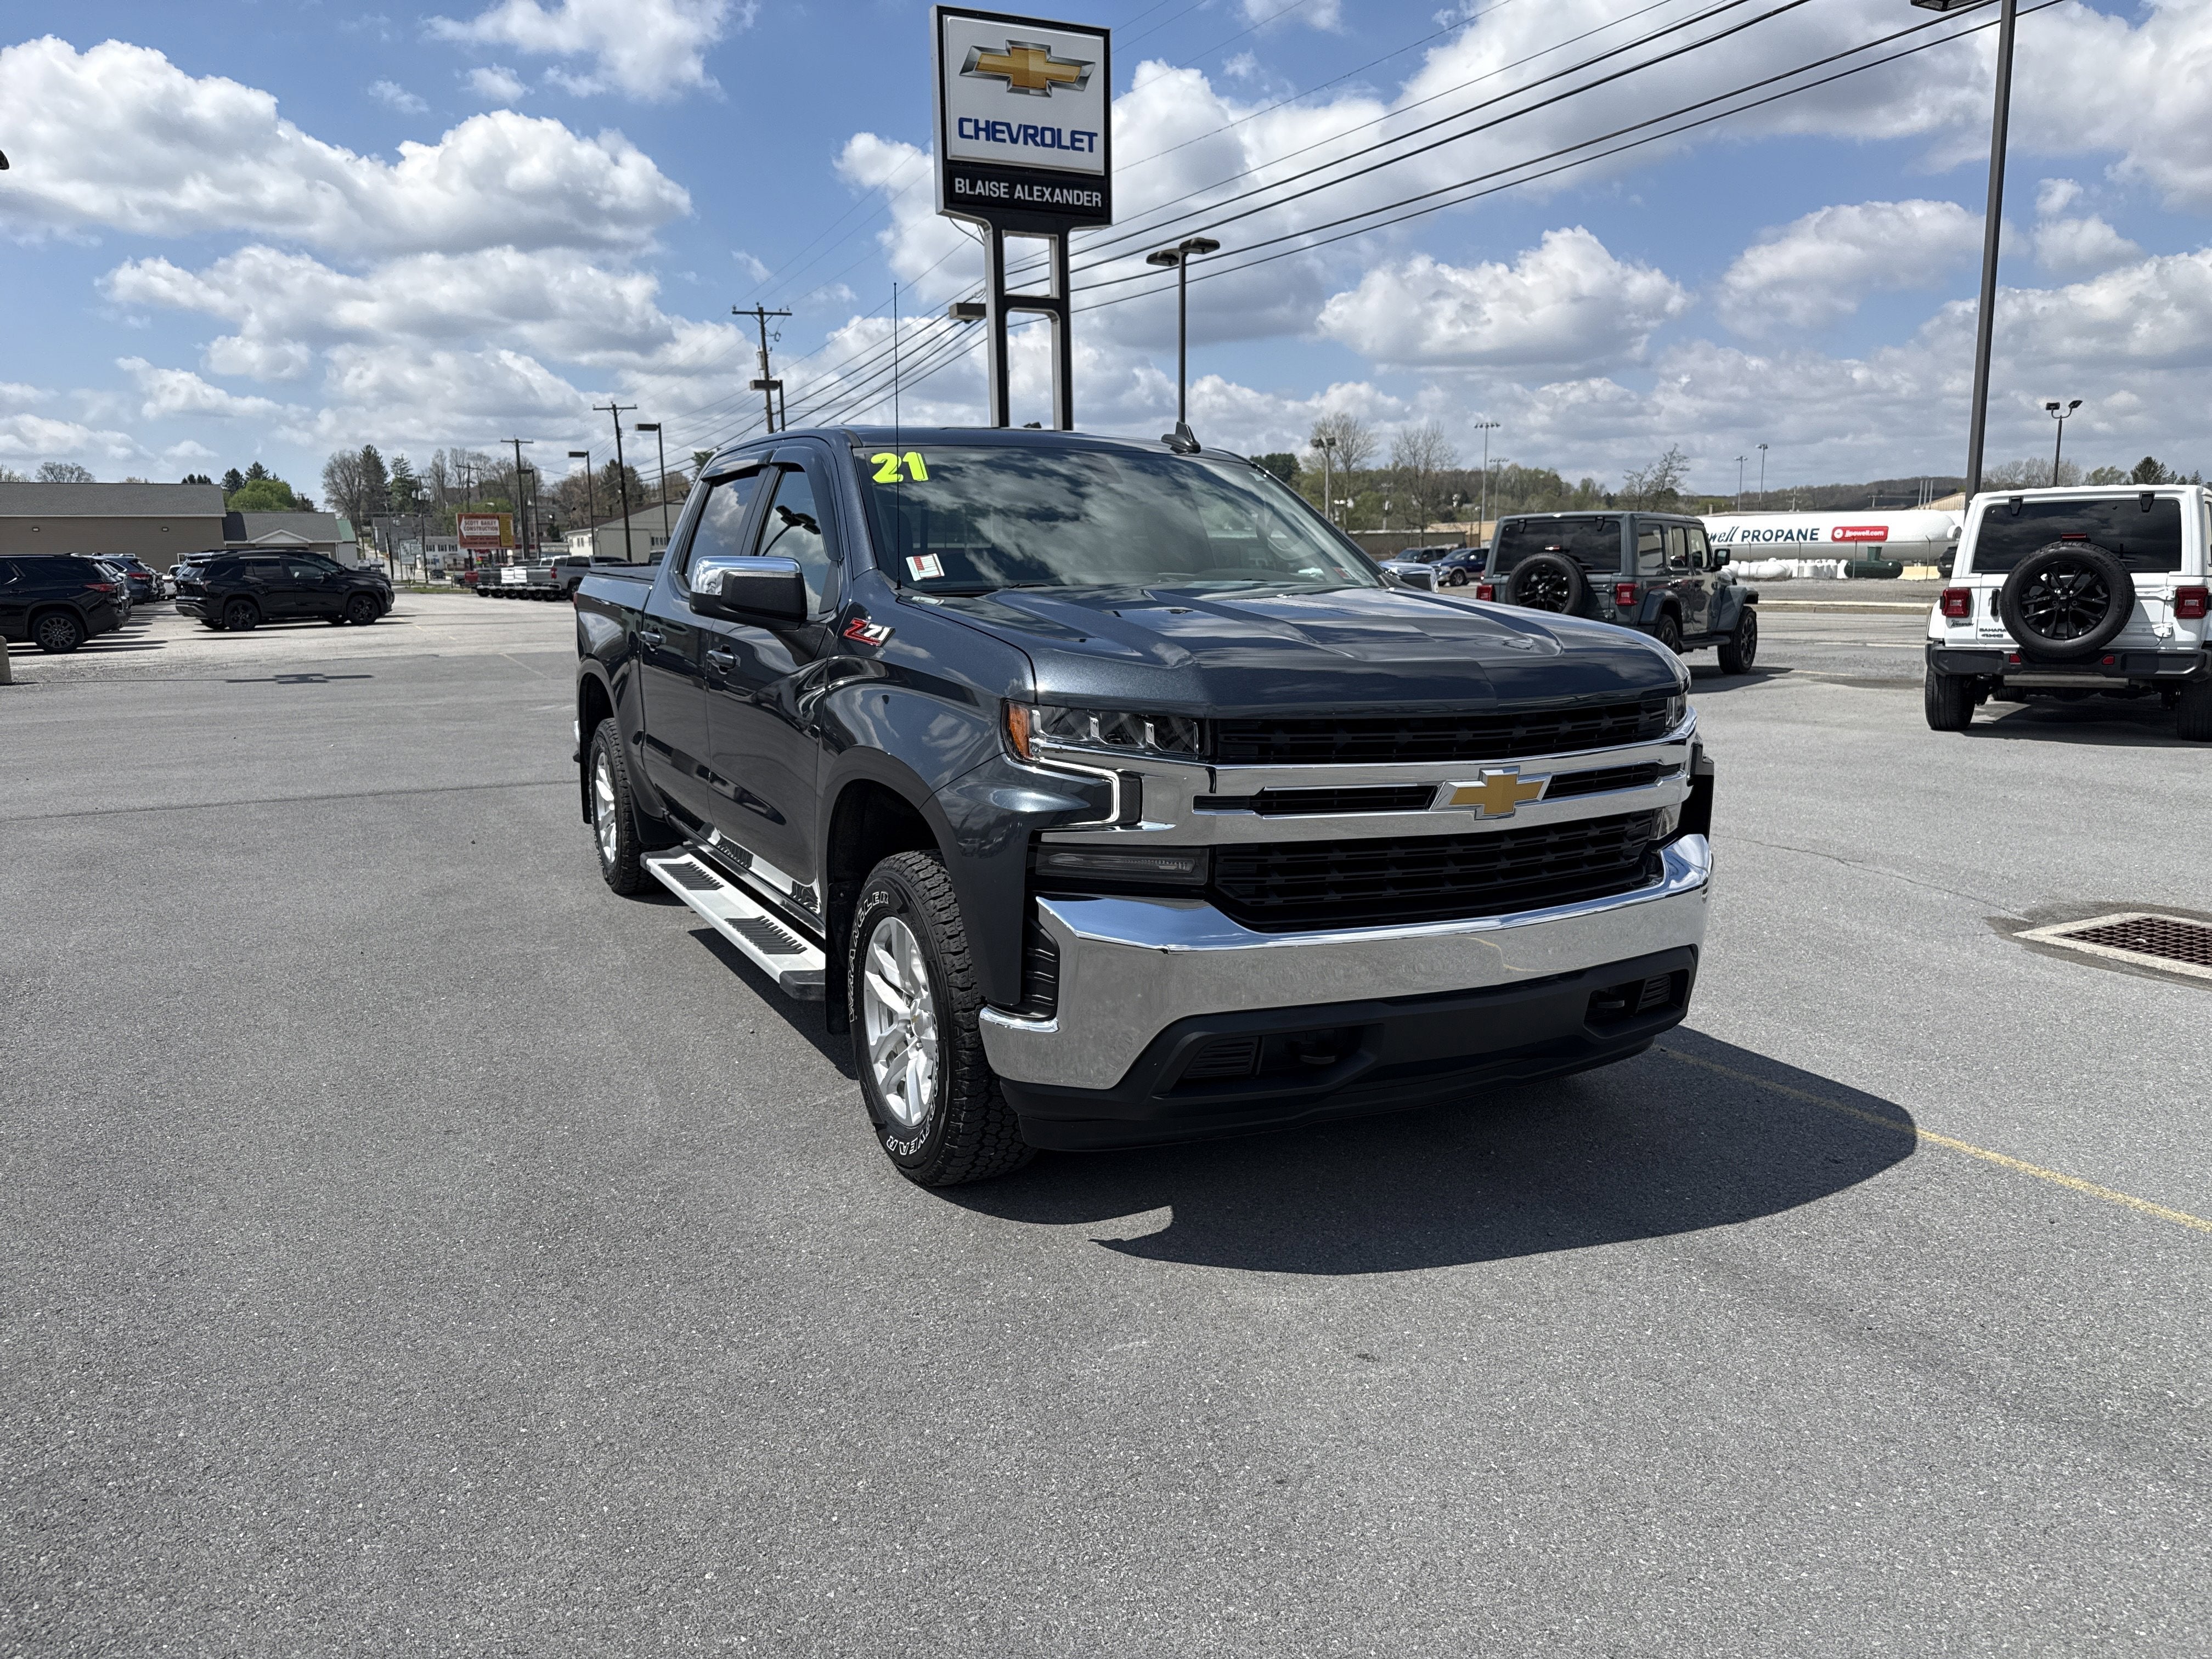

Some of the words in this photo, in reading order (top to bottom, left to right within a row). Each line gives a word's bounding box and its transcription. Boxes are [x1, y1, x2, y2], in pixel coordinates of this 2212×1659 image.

[958, 117, 1098, 153] CHEVROLET
[955, 177, 1009, 199] BLAISE
[1014, 184, 1102, 207] ALEXANDER
[870, 451, 929, 484] 21
[1708, 526, 1740, 542] well
[1741, 528, 1820, 542] PROPANE
[848, 890, 889, 1023] WRANGLER
